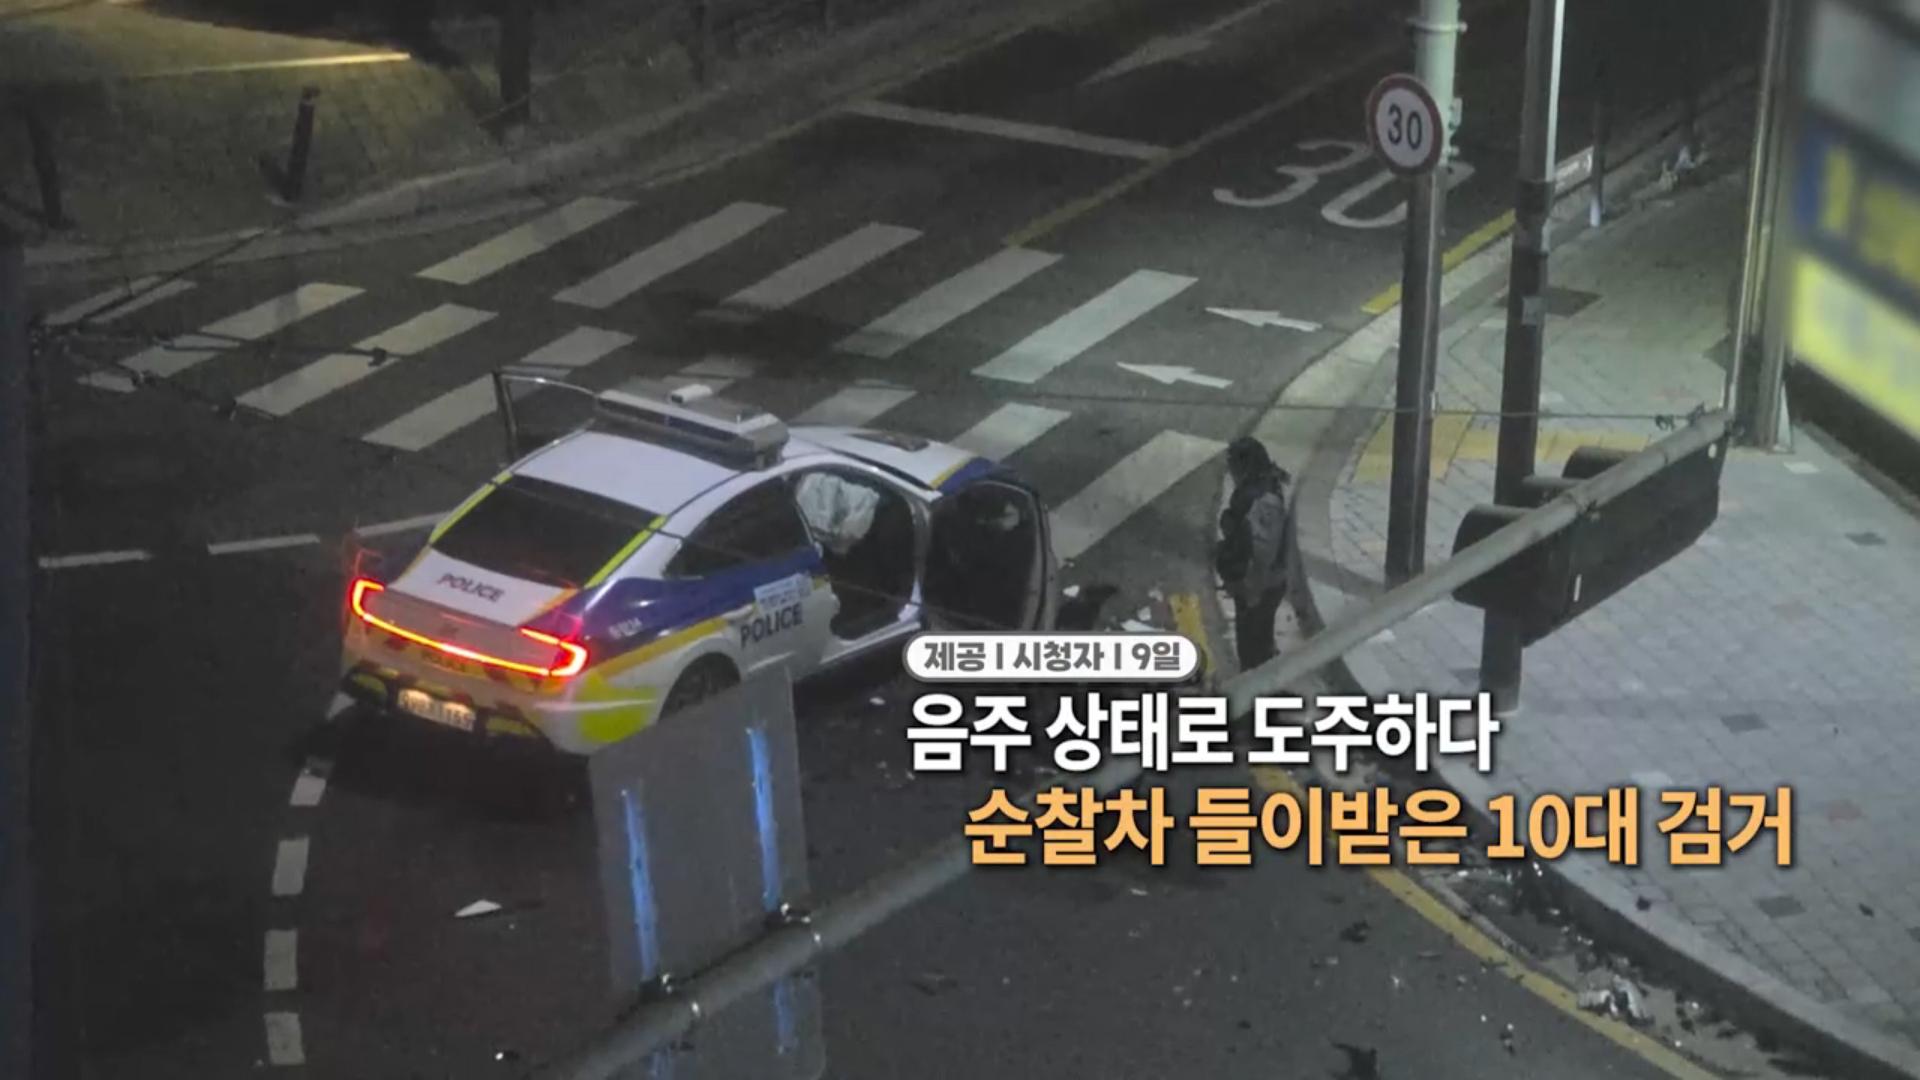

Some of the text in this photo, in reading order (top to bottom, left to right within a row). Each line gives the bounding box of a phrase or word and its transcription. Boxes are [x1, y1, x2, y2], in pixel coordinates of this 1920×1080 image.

[1387, 103, 1422, 150] 30
[1212, 138, 1475, 229] 30
[436, 572, 505, 603] POLICE
[740, 601, 803, 650] POLICE
